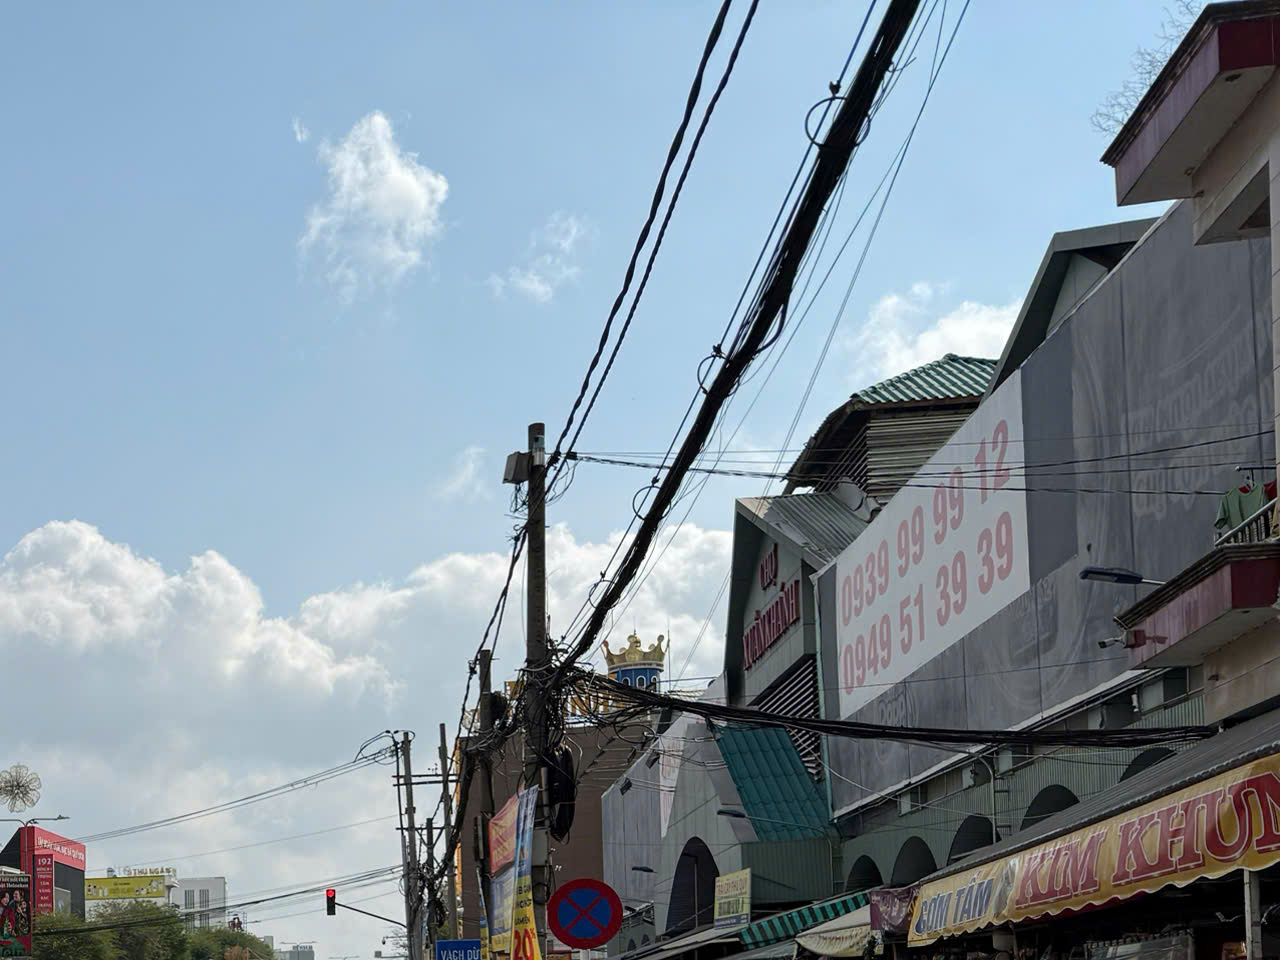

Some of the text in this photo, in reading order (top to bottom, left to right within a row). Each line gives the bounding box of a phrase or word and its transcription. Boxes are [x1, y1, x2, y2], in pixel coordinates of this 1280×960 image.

[841, 419, 1010, 626] 0939 99 99 12
[841, 511, 1013, 695] 0949 51 39 39
[1016, 830, 1106, 909] KIM
[467, 946, 481, 960] DỪ
